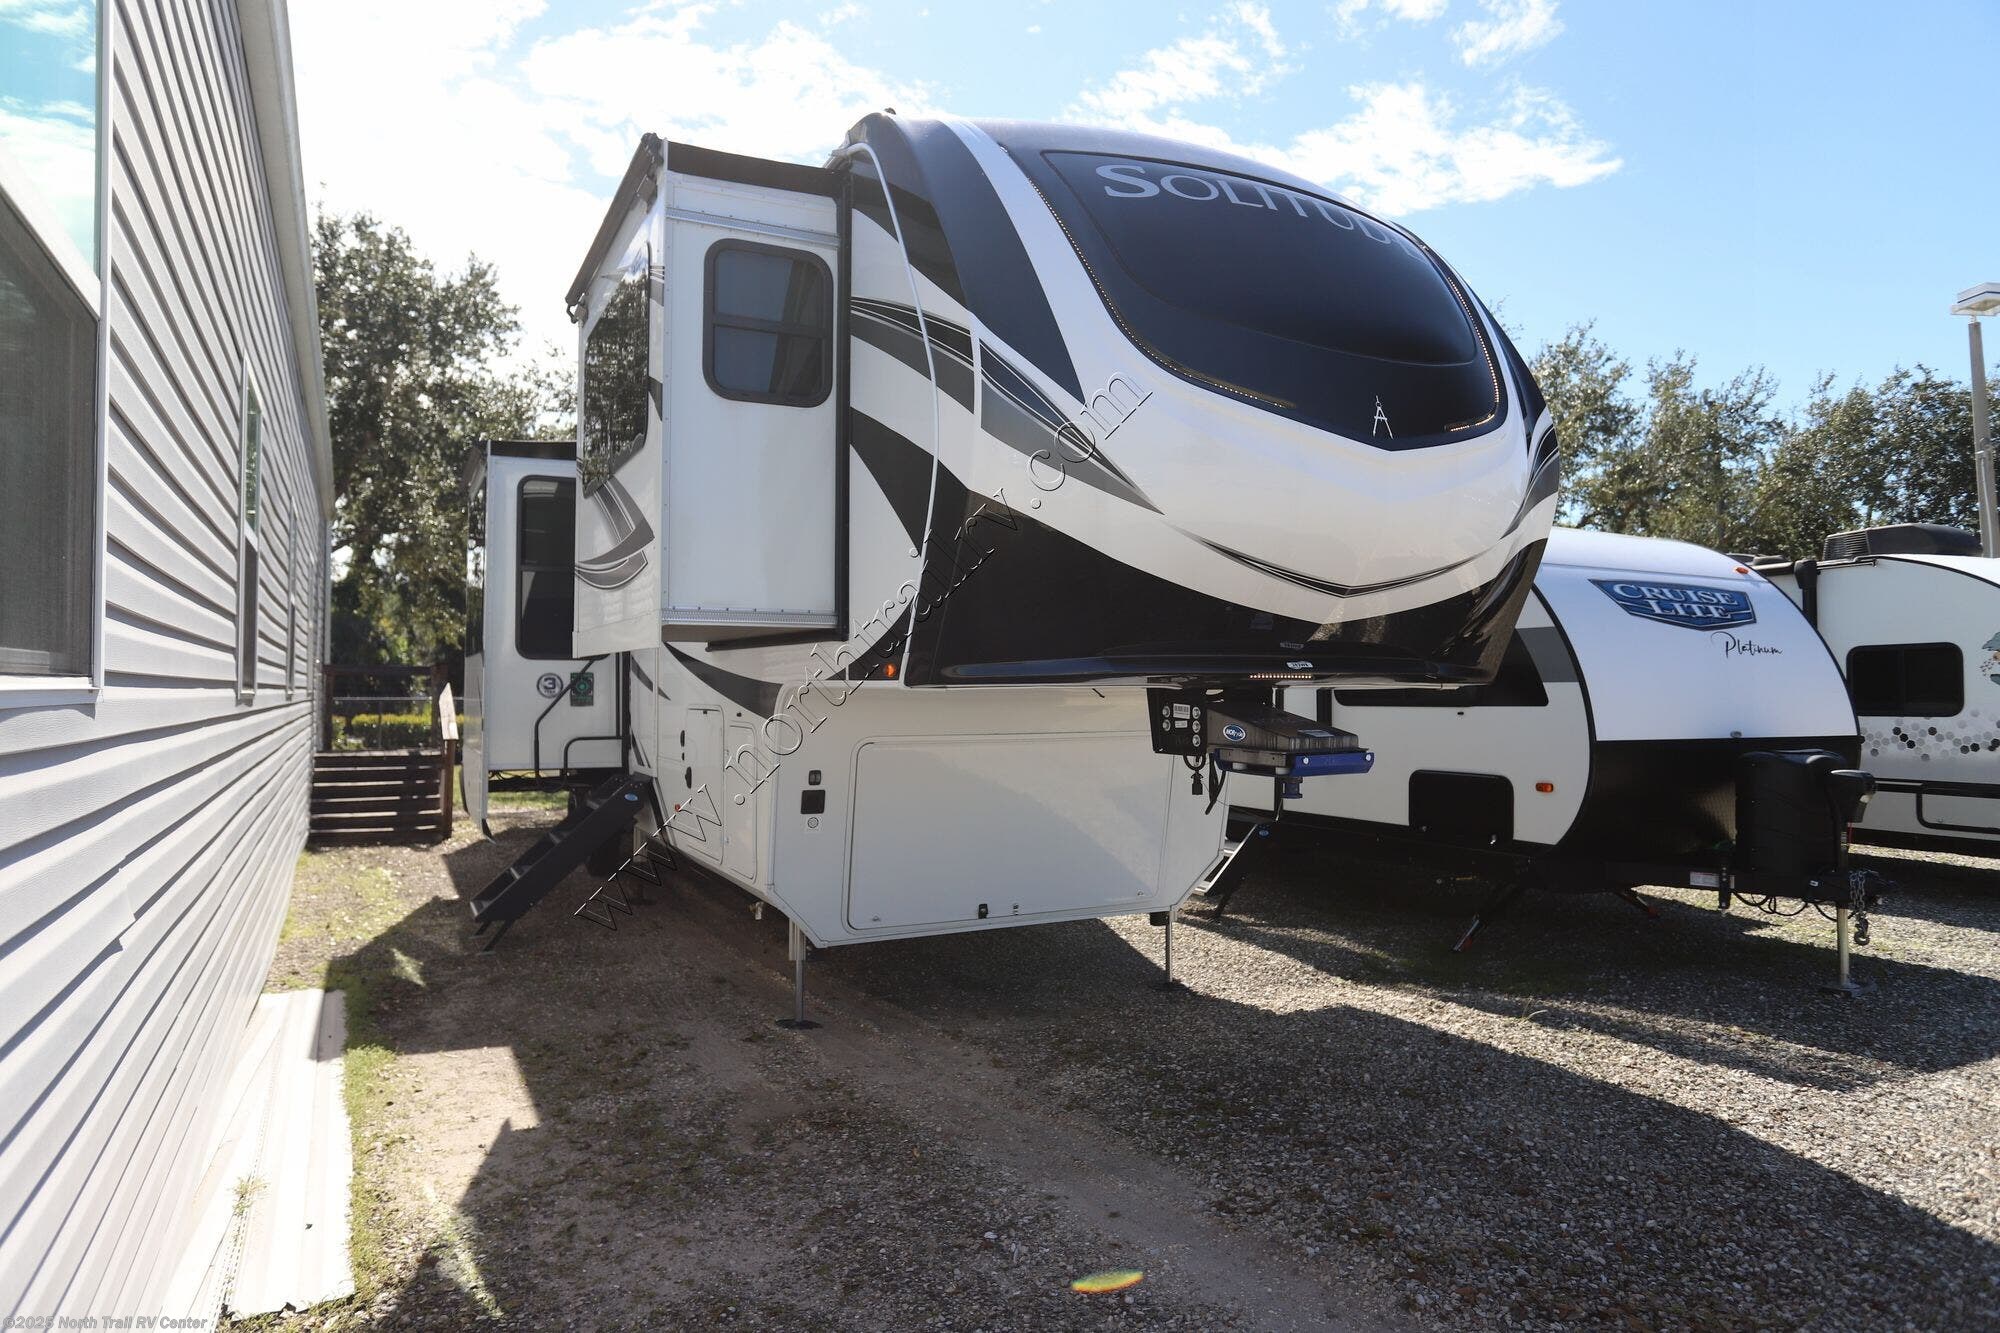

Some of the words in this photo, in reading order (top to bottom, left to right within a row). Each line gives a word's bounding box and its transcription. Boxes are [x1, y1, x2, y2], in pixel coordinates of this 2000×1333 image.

[1613, 583, 1738, 605] CRUISE
[1649, 600, 1733, 619] LITE
[1710, 631, 1783, 659] Platinum
[543, 677, 556, 690] 3
